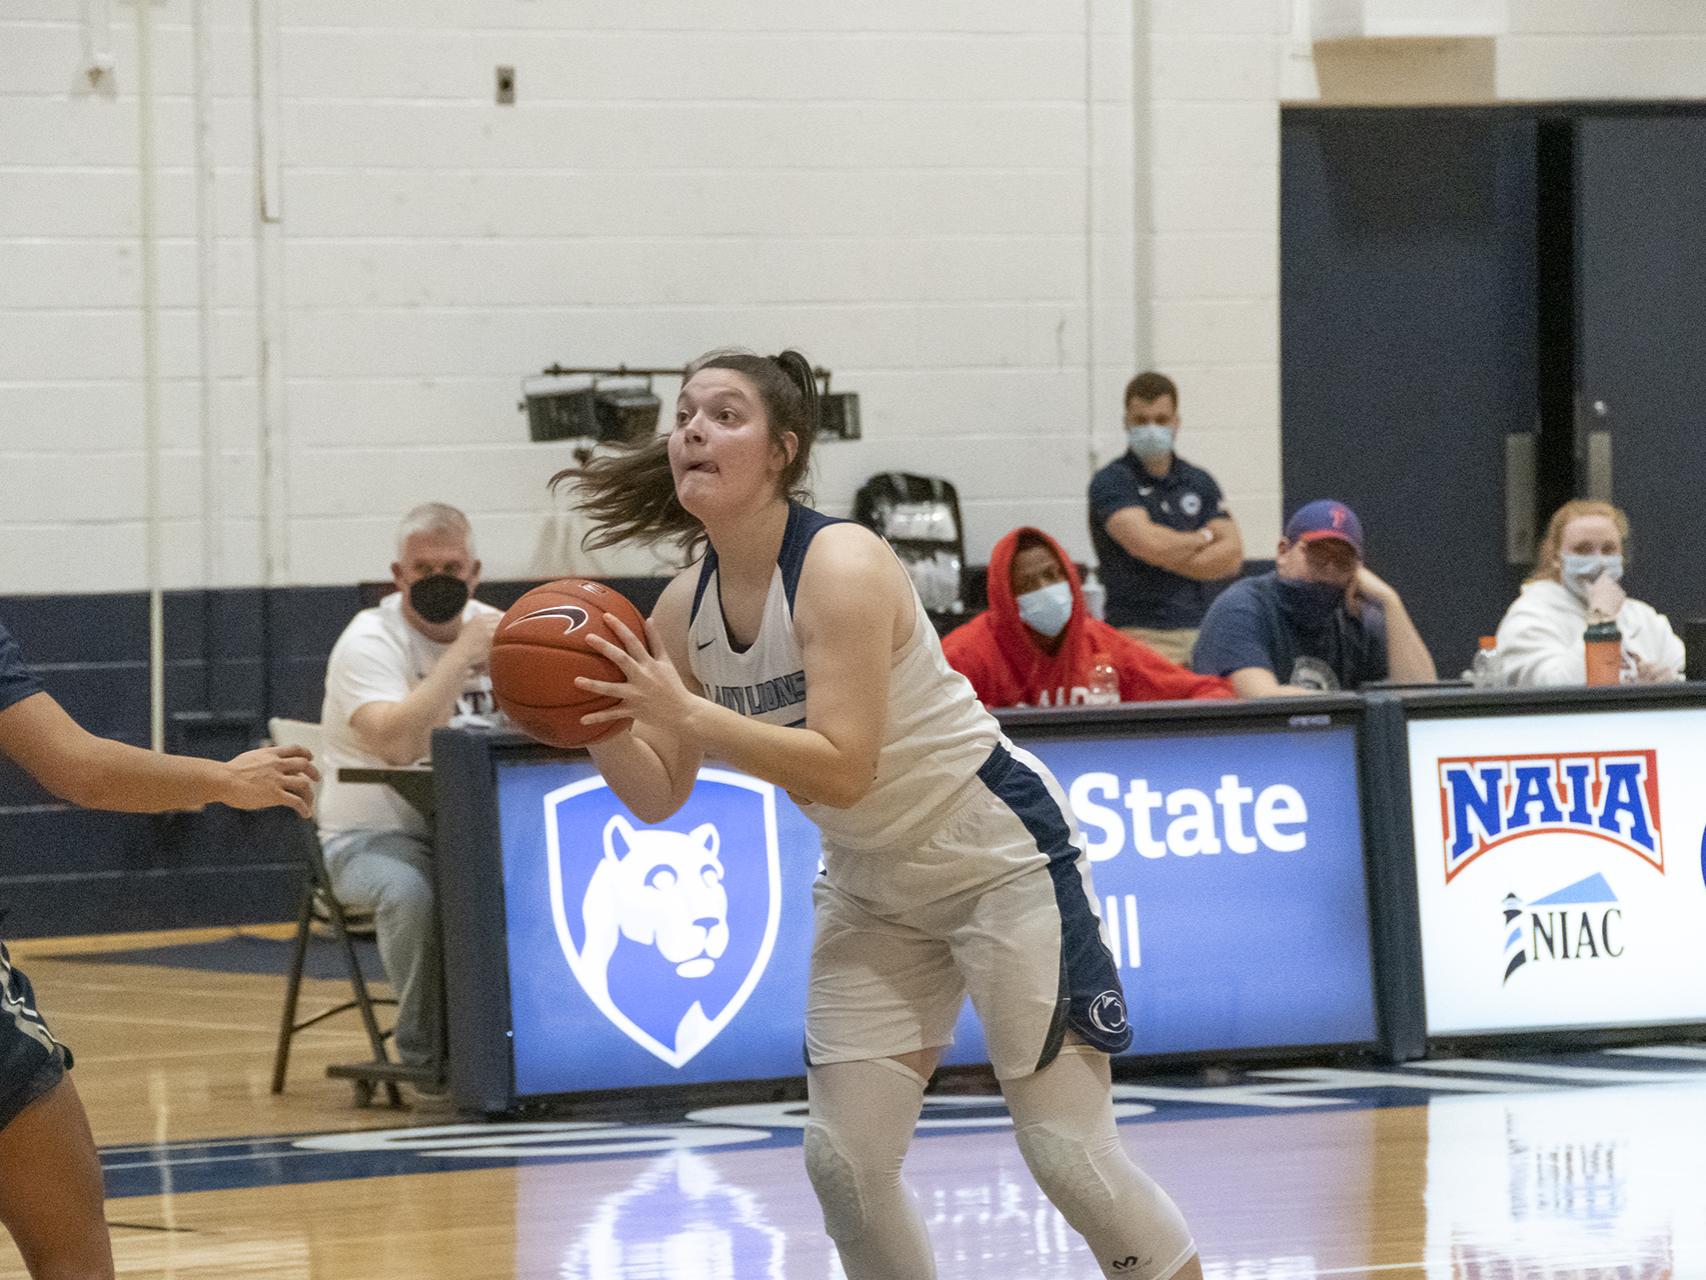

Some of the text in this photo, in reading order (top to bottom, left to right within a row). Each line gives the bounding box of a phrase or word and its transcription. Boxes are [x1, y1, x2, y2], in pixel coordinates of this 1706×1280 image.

[1069, 771, 1308, 862] State
[1446, 762, 1656, 861] NAIA
[1531, 908, 1625, 961] NIAC
